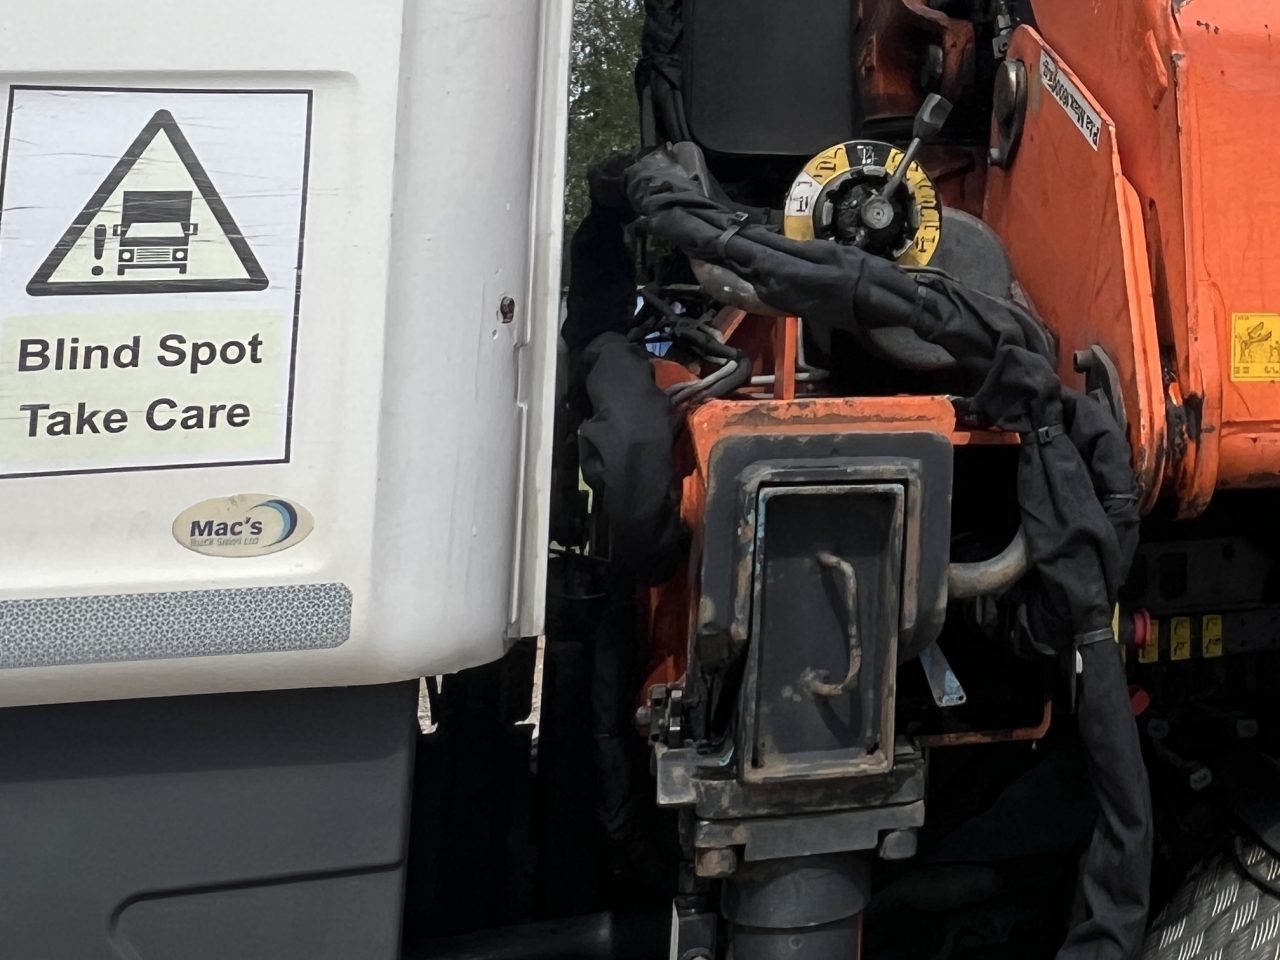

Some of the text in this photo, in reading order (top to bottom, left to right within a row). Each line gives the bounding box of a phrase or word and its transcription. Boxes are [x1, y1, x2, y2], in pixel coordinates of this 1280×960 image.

[18, 333, 263, 374] Blind Spot
[19, 398, 250, 437] Take Care
[190, 517, 263, 537] Mac's
